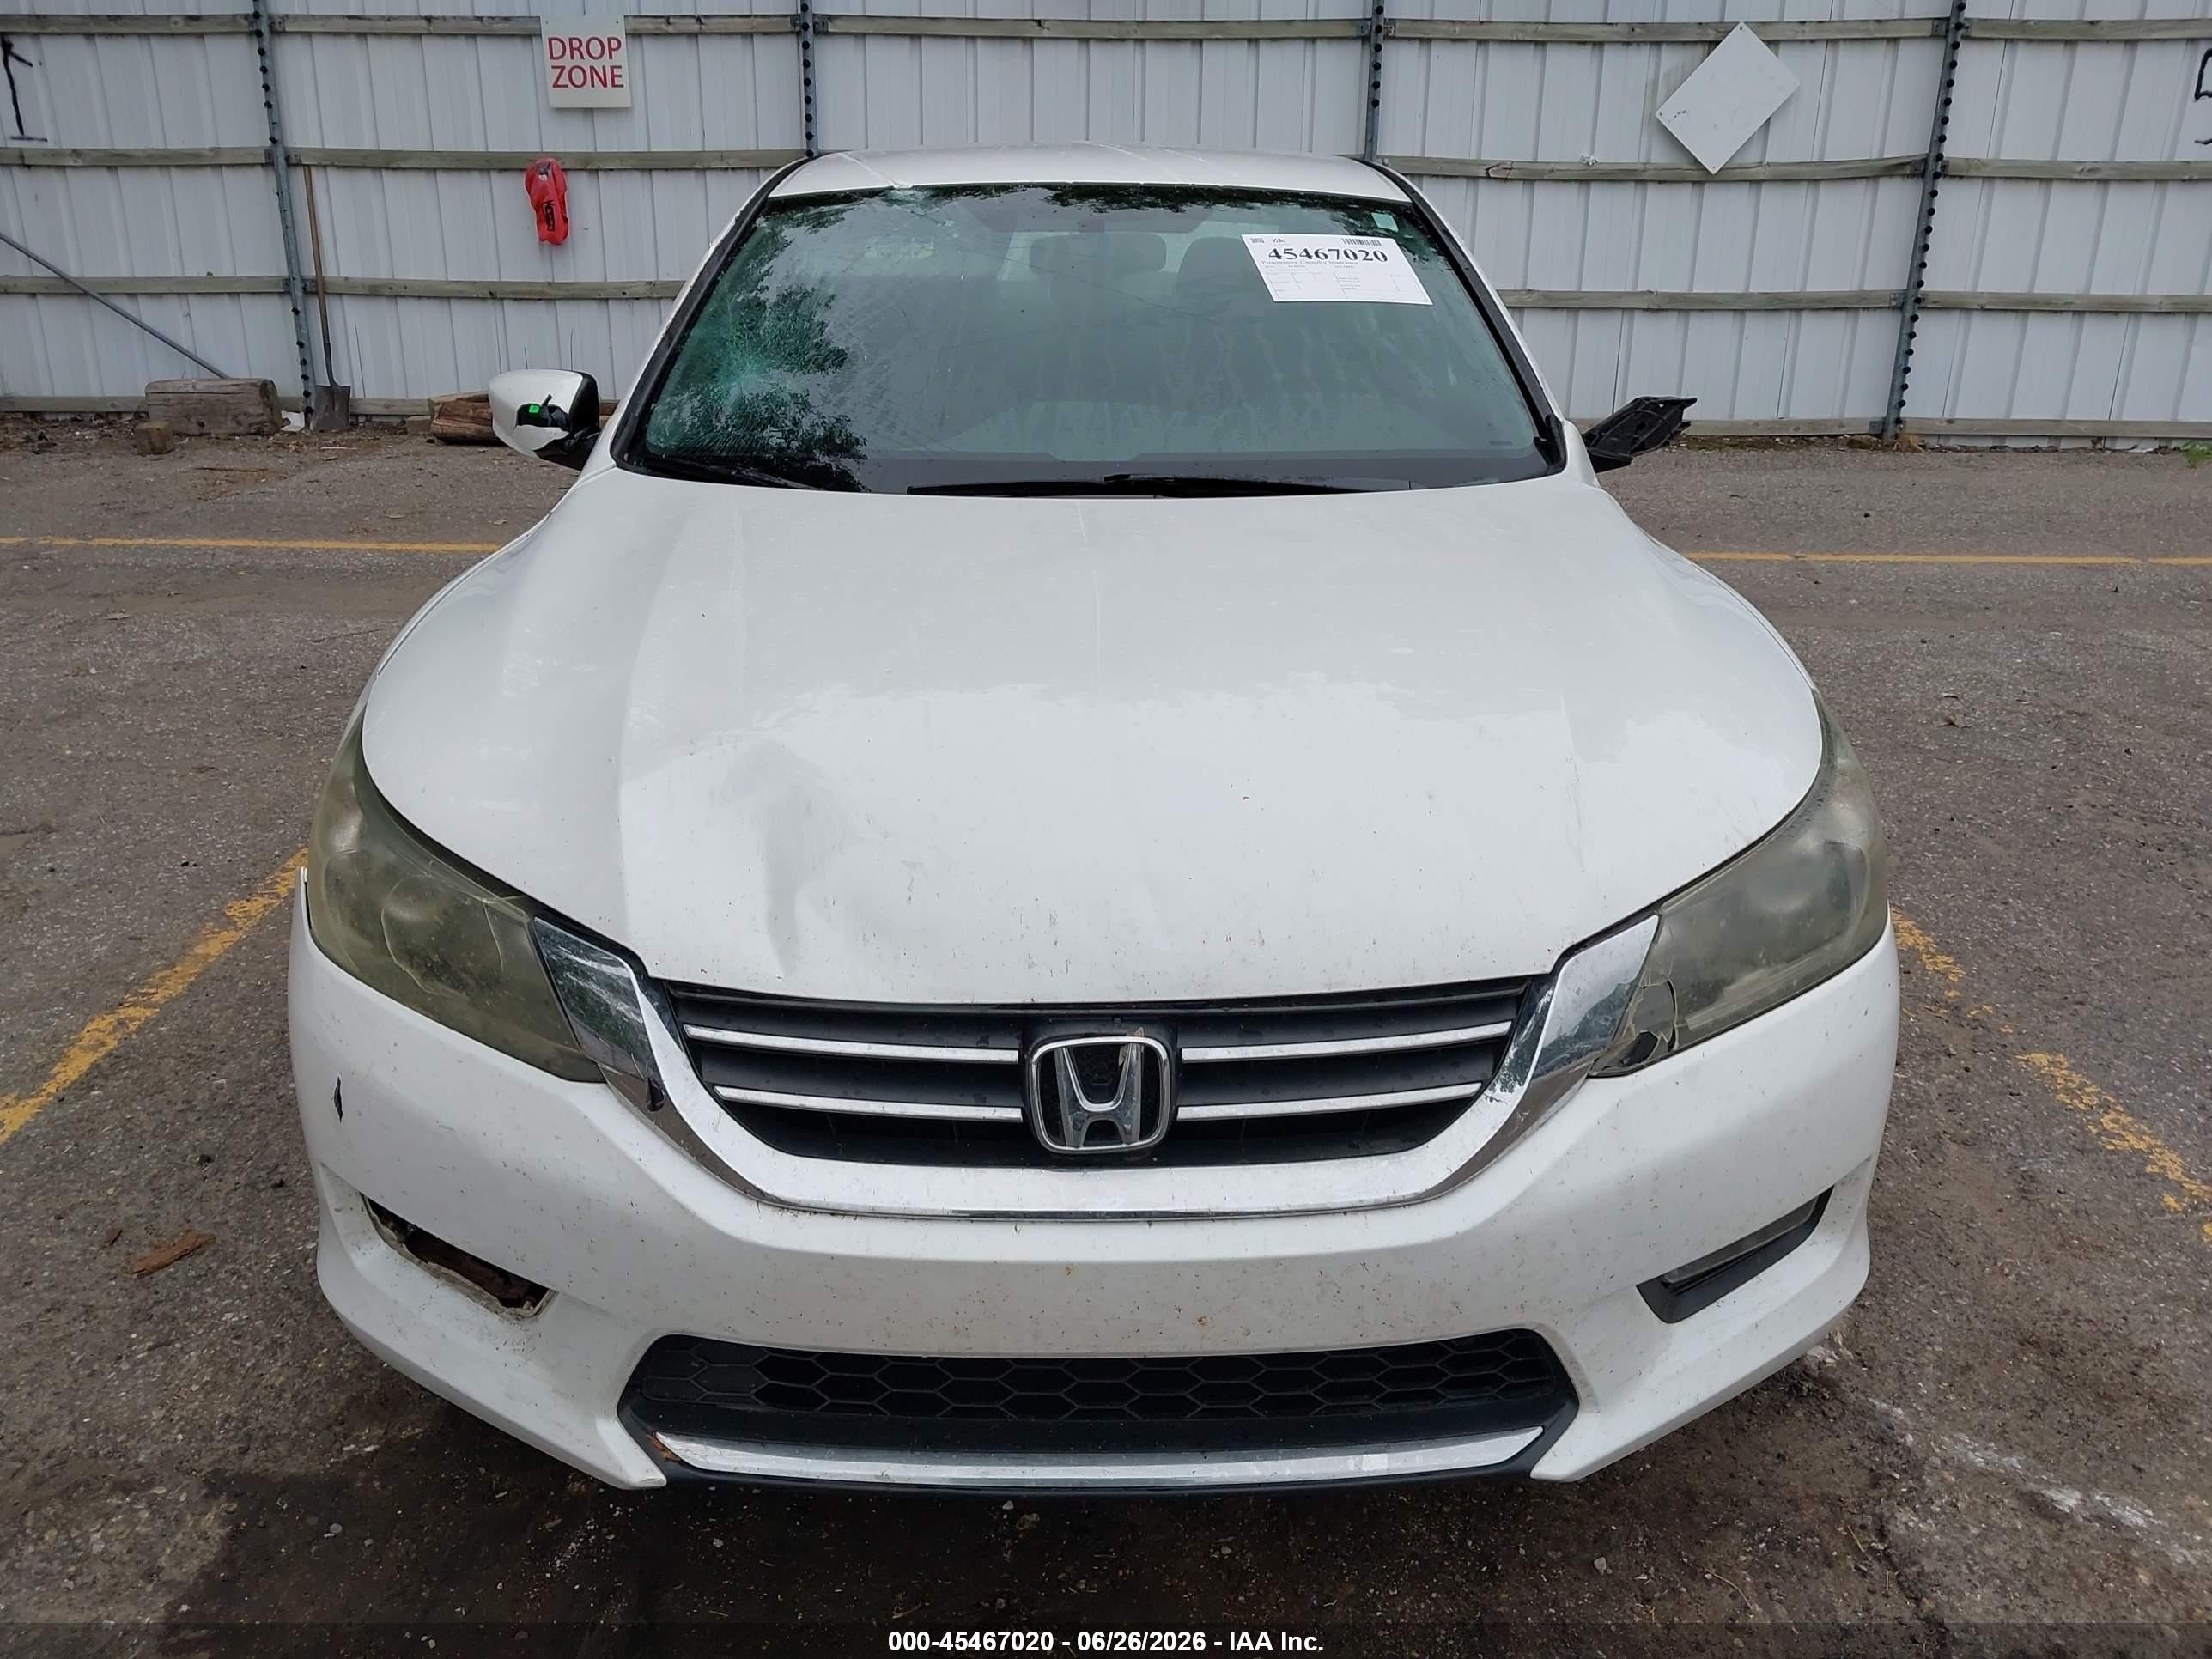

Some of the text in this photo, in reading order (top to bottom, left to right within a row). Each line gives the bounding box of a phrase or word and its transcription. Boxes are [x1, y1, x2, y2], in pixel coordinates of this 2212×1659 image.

[547, 36, 623, 61] DROP
[550, 64, 625, 89] ZONE
[1267, 247, 1389, 263] 45467020
